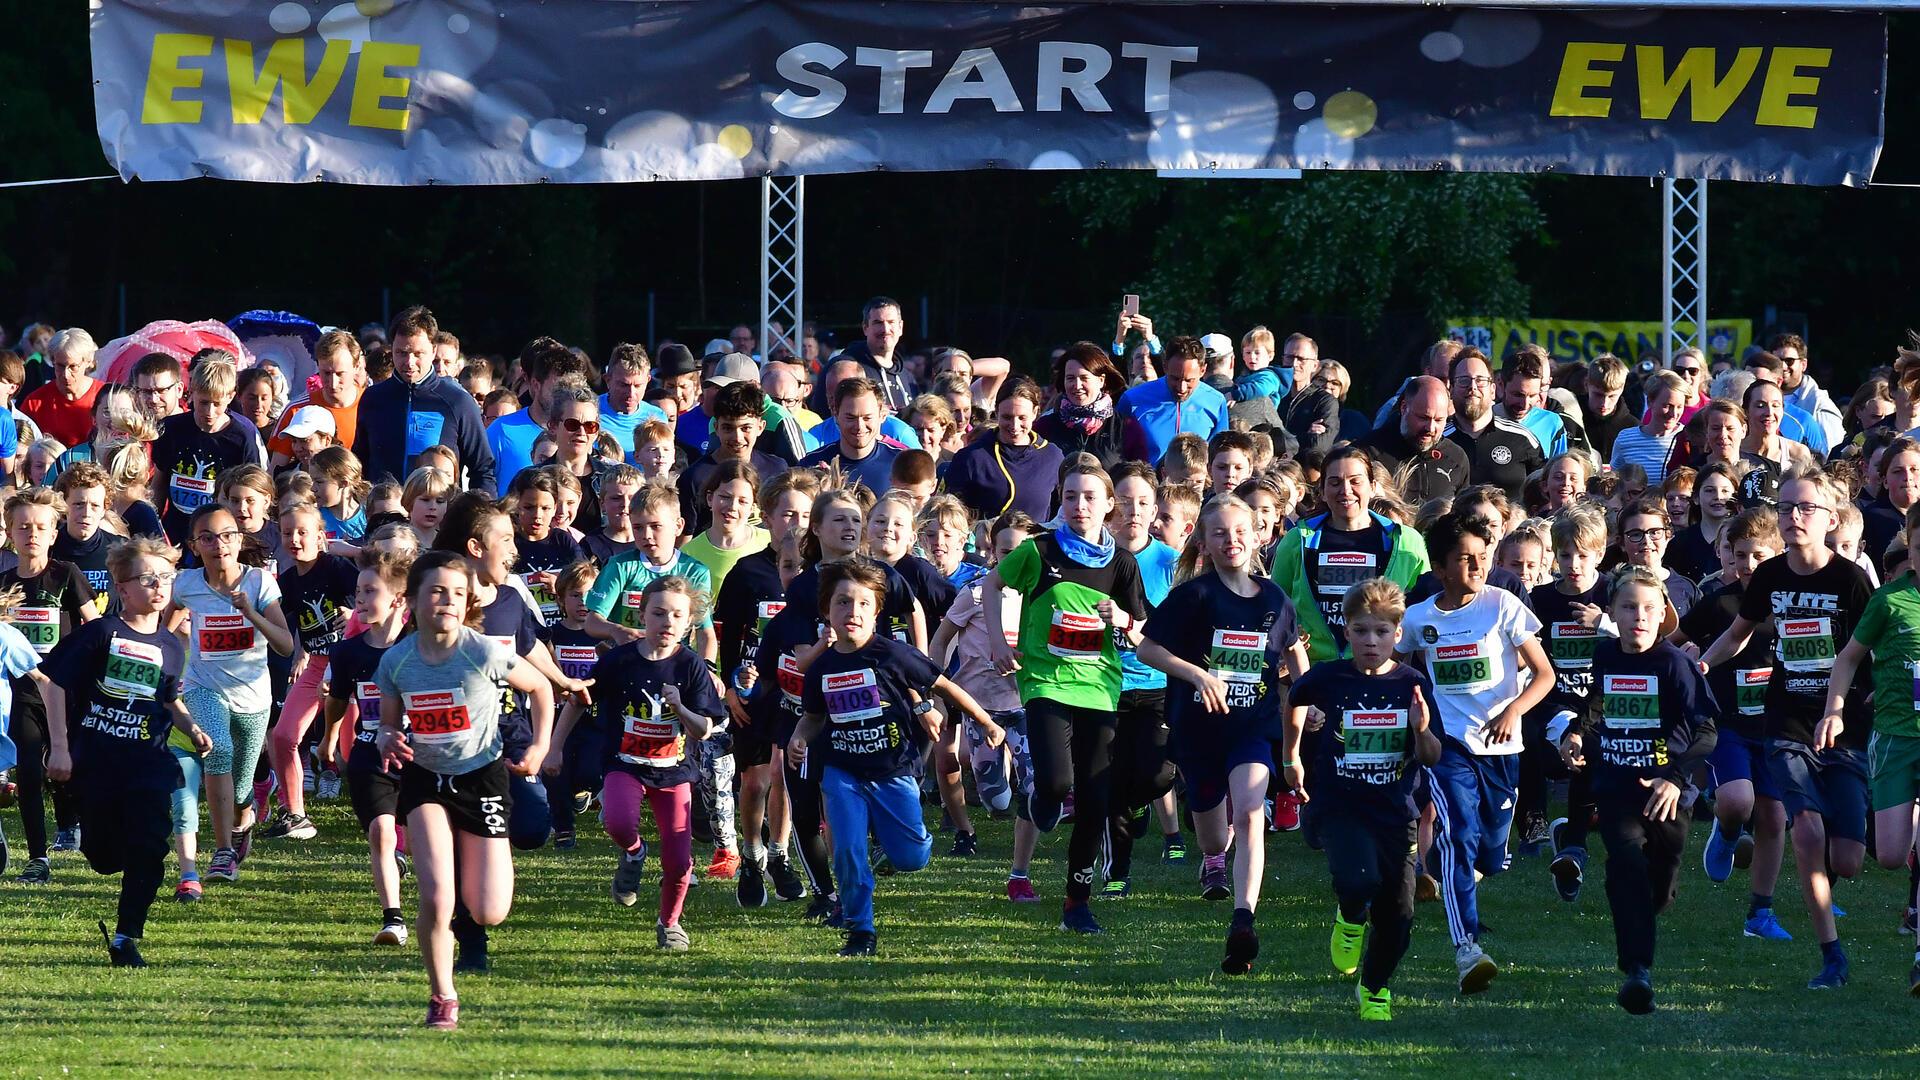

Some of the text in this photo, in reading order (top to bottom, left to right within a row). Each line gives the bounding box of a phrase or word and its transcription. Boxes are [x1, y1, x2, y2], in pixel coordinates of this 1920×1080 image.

[141, 33, 421, 130] EWE
[771, 41, 1199, 119] START
[1549, 42, 1832, 128] EWE
[206, 618, 243, 626] dodenhof
[1787, 625, 1820, 633] dodenhof
[20, 626, 54, 642] 913
[202, 631, 251, 650] 3238
[1223, 637, 1258, 646] dodenhof
[1439, 648, 1477, 657] dodenhof
[1786, 639, 1829, 657] 4608
[1214, 651, 1261, 671] 4496
[109, 660, 156, 684] 4783
[1438, 661, 1486, 681] 4498
[828, 677, 863, 687] dodenhof
[829, 689, 874, 713] 4109
[1228, 695, 1257, 707] ACHT
[1606, 697, 1653, 716] 4867
[97, 719, 142, 739] NACHT
[412, 710, 465, 731] 2945
[848, 737, 889, 754] NACHT
[1348, 731, 1401, 751] 4715
